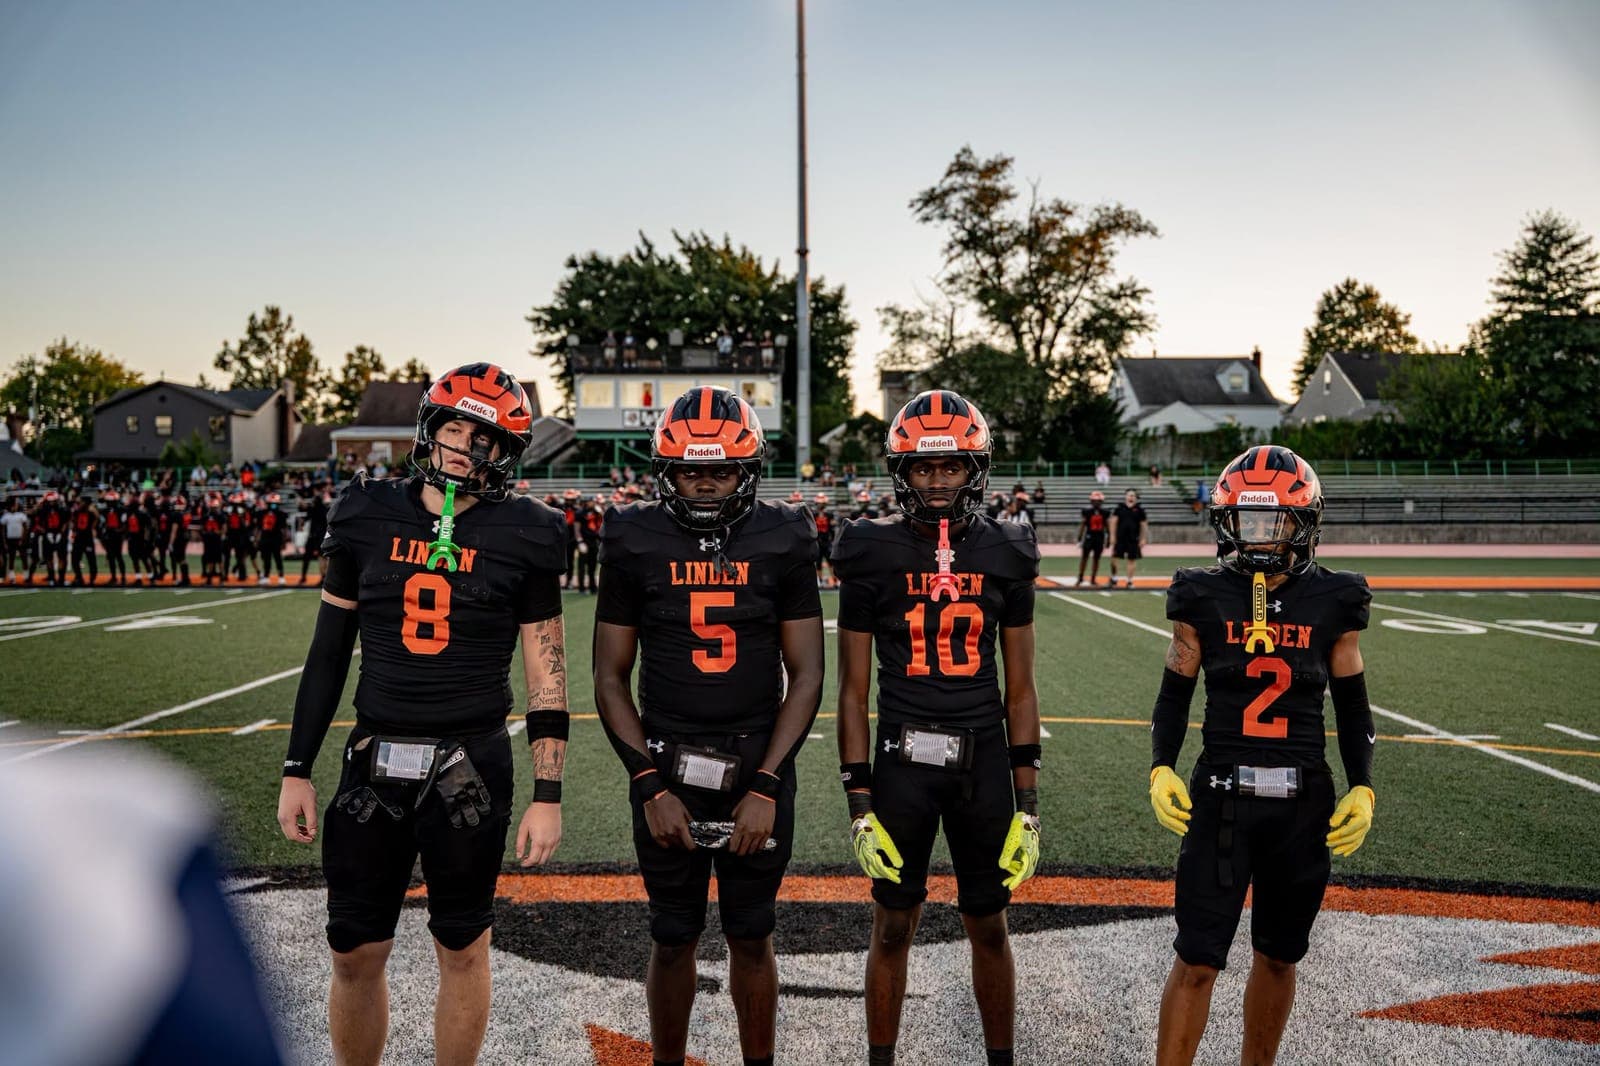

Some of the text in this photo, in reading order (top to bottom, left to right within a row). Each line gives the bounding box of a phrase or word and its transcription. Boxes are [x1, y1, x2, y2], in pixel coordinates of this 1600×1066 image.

[687, 448, 721, 456] Riddell
[920, 439, 953, 448] Riddell
[1240, 494, 1274, 503] Riddell
[390, 537, 478, 573] LINN
[402, 573, 451, 655] 8
[690, 592, 736, 673] 5
[905, 603, 984, 676] 10
[1243, 657, 1291, 738] 2
